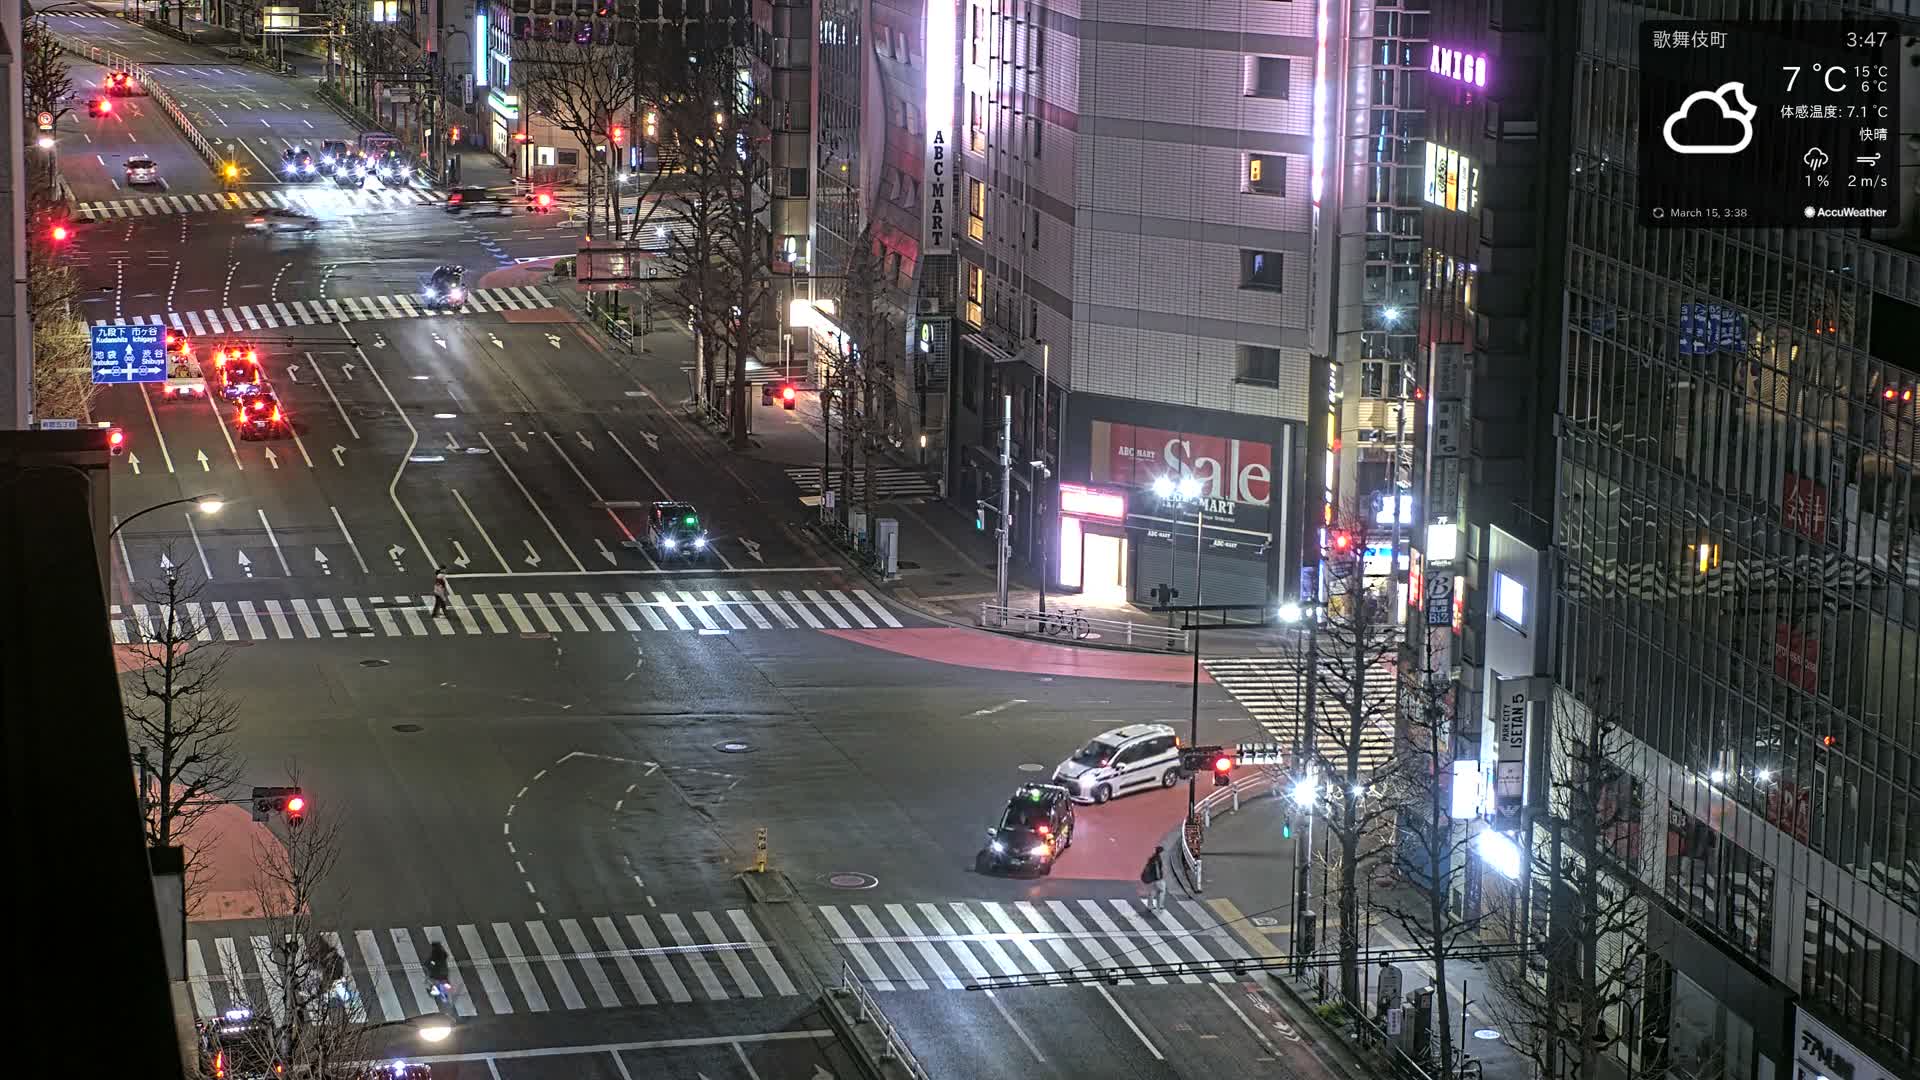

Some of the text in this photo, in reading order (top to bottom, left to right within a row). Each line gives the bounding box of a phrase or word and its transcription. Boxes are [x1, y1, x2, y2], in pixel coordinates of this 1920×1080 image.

[1430, 44, 1486, 87] AMIGO
[932, 130, 944, 246] ABC-MART
[98, 327, 126, 337] 九段下
[1163, 438, 1271, 505] Sale
[1502, 704, 1511, 742] PARK CITY
[1510, 693, 1524, 748] ISETAN 5
